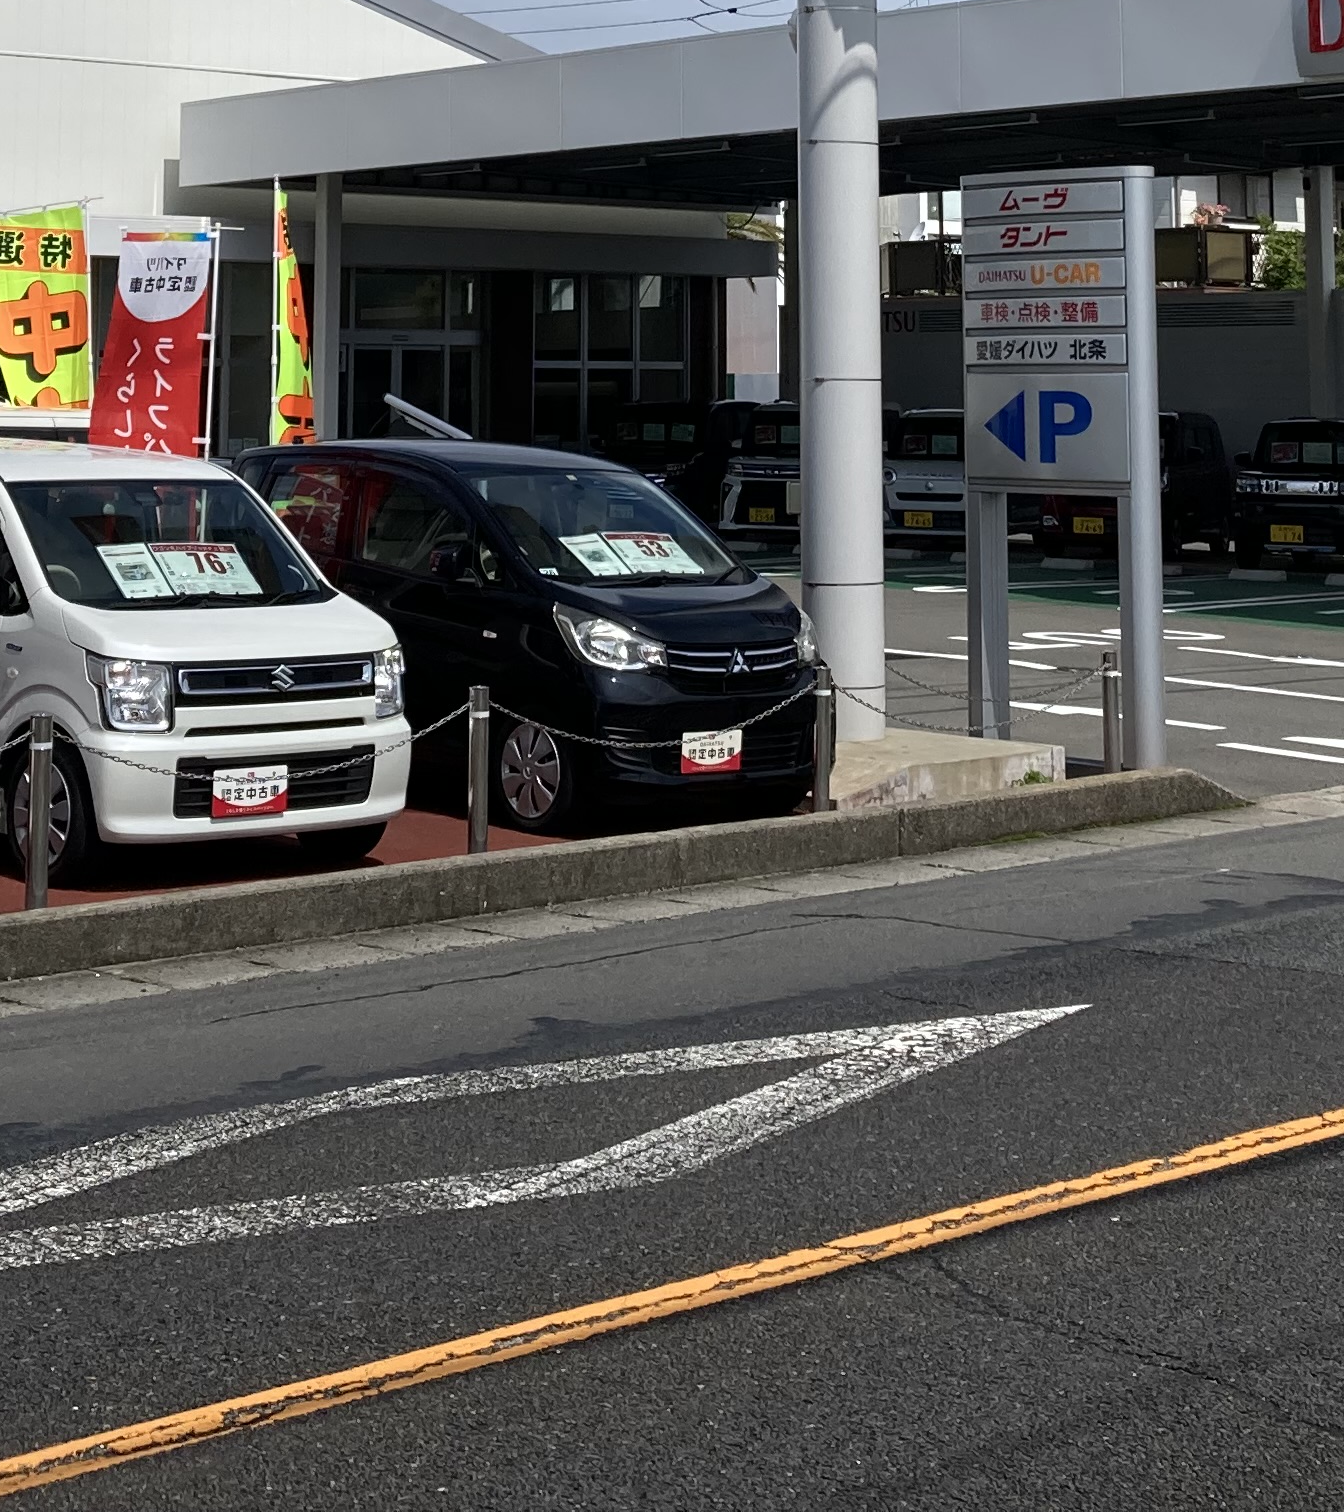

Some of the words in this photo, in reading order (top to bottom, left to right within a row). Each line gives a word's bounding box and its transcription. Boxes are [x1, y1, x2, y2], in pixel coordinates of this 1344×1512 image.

[999, 187, 1069, 212] ムーヴ
[1000, 224, 1068, 249] タント
[978, 269, 1027, 284] DAIHATSU
[1030, 261, 1101, 286] U-CAR
[976, 339, 1059, 361] 愛媛ダイハツ
[1069, 338, 1107, 361] 北条
[1038, 390, 1093, 464] P
[221, 784, 280, 802] 認定中古車
